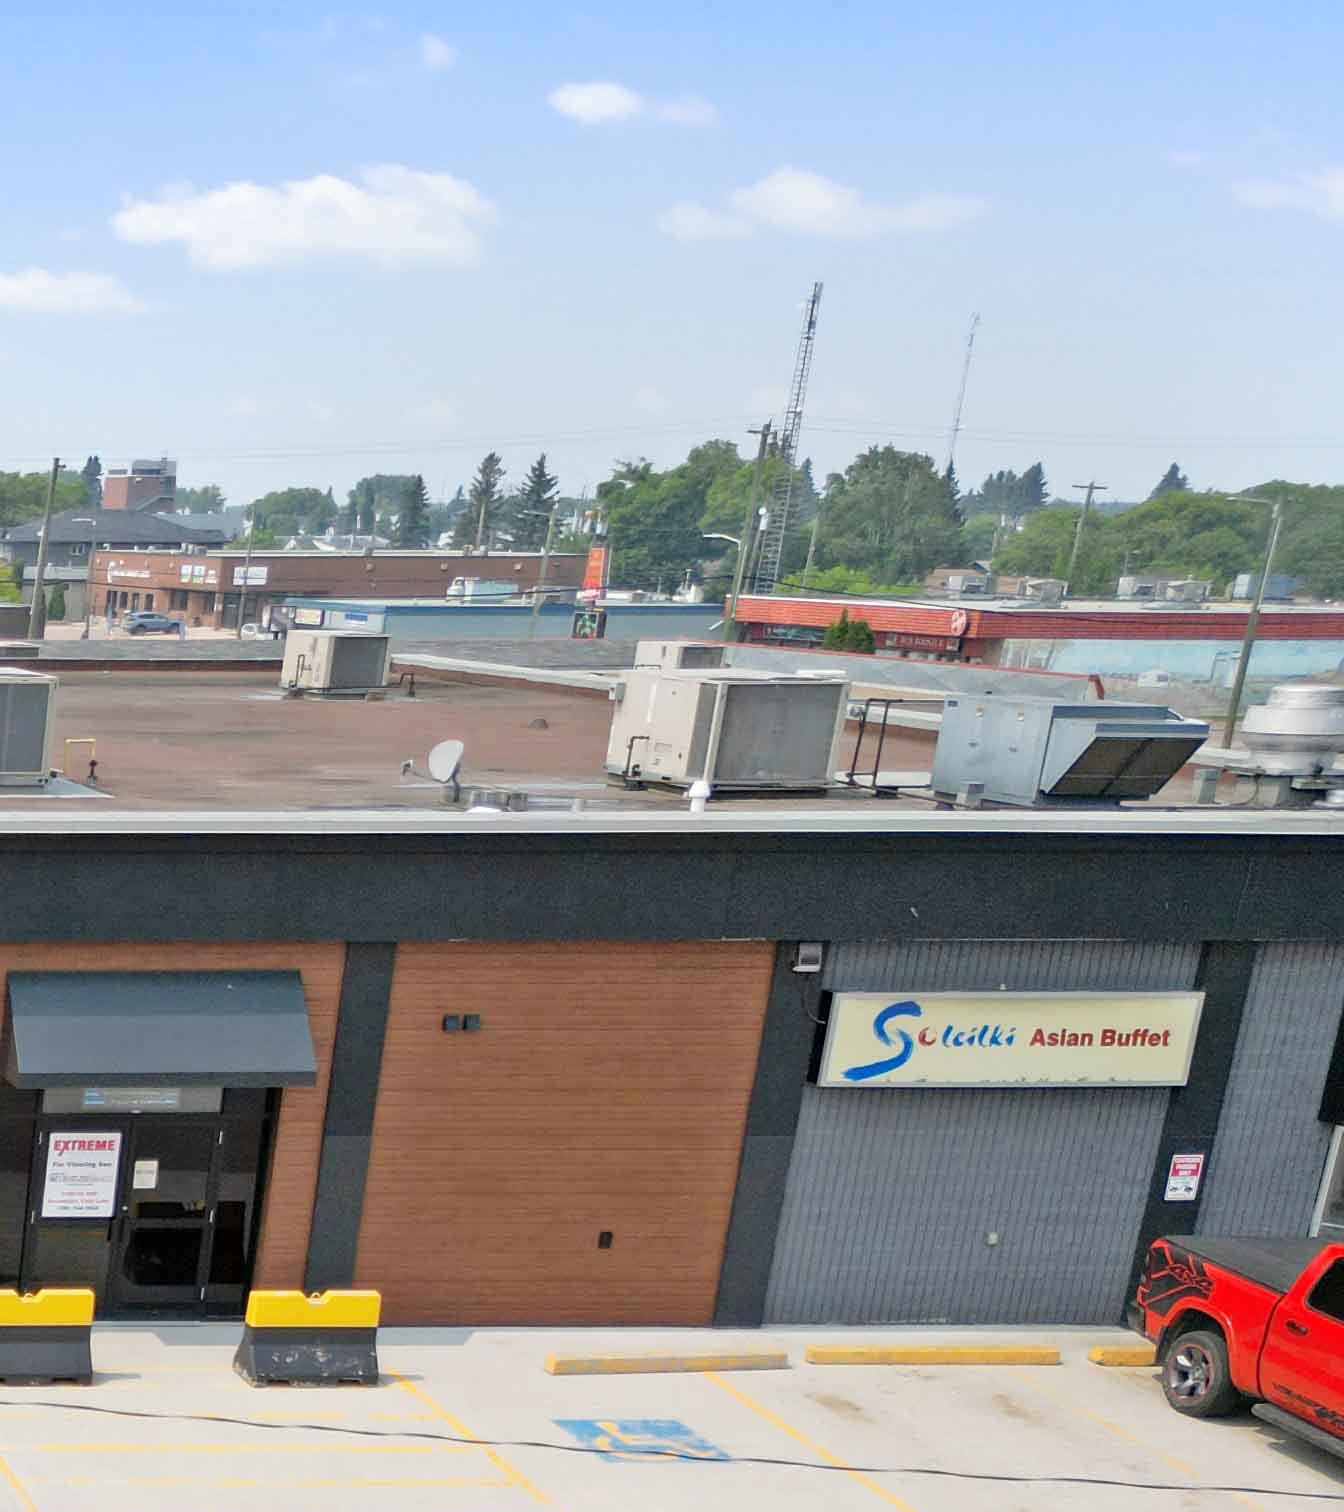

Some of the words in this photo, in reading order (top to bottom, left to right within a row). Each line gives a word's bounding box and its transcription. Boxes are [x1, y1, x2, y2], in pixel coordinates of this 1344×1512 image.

[1030, 1028, 1094, 1047] Asian
[1100, 1028, 1170, 1047] Buffet
[53, 1140, 115, 1152] EXTREME
